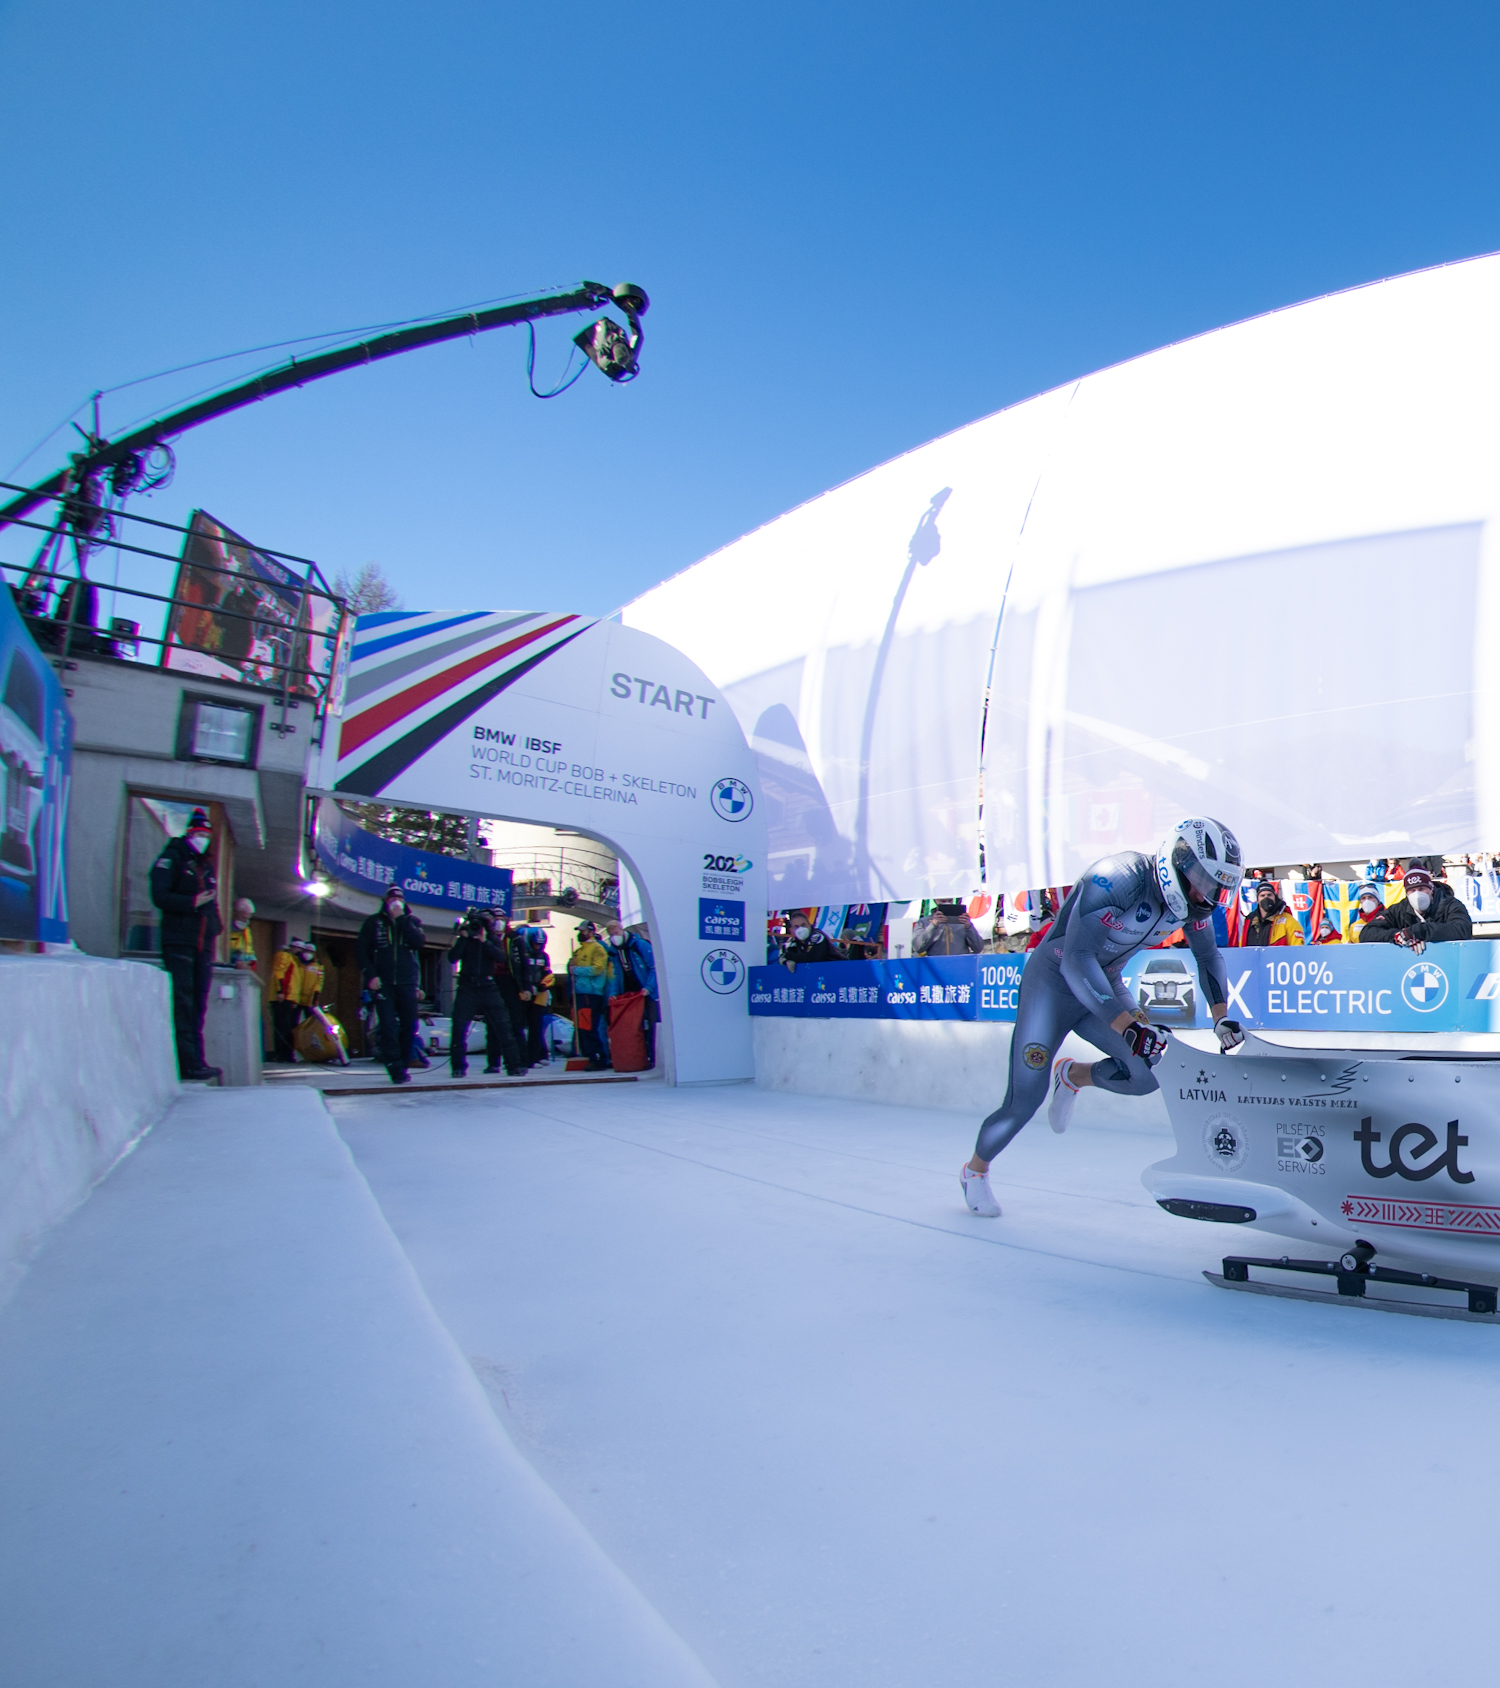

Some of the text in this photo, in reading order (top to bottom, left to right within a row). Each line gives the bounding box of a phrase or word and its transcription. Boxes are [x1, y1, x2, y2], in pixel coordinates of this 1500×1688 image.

[610, 672, 716, 720] START
[473, 726, 562, 755] BMW IBSF
[471, 744, 698, 799] WORLD CUP BOB + SKELETON
[470, 764, 638, 806] ST. MORITZ-CELERINA
[1195, 829, 1206, 860] Binders
[702, 876, 744, 886] BOBSLEIGH
[1158, 856, 1173, 891] tet
[1407, 874, 1422, 885] tet
[404, 877, 443, 896] caissa
[447, 881, 506, 906] 凯撒旅游
[702, 883, 741, 892] SKELETON
[704, 915, 740, 926] caissa
[981, 966, 1021, 986] 100%
[1266, 961, 1333, 986] 100%
[751, 991, 772, 1004] caissa
[773, 988, 804, 1003] 凯撒旅游
[811, 990, 836, 1004] caissa
[838, 987, 878, 1004] 凯撒旅游
[887, 990, 916, 1005] caissa
[920, 984, 970, 1004] 凯撒旅游
[981, 989, 1019, 1009] ELEC
[1268, 990, 1392, 1015] ELECTRIC
[1180, 1088, 1227, 1102] LATVIJA
[1237, 1096, 1358, 1109] LATVIJAS VALSTS MEŽI
[1276, 1122, 1326, 1137] PILSĒTAS
[1353, 1116, 1476, 1184] tet
[1278, 1160, 1326, 1175] SERVISS
